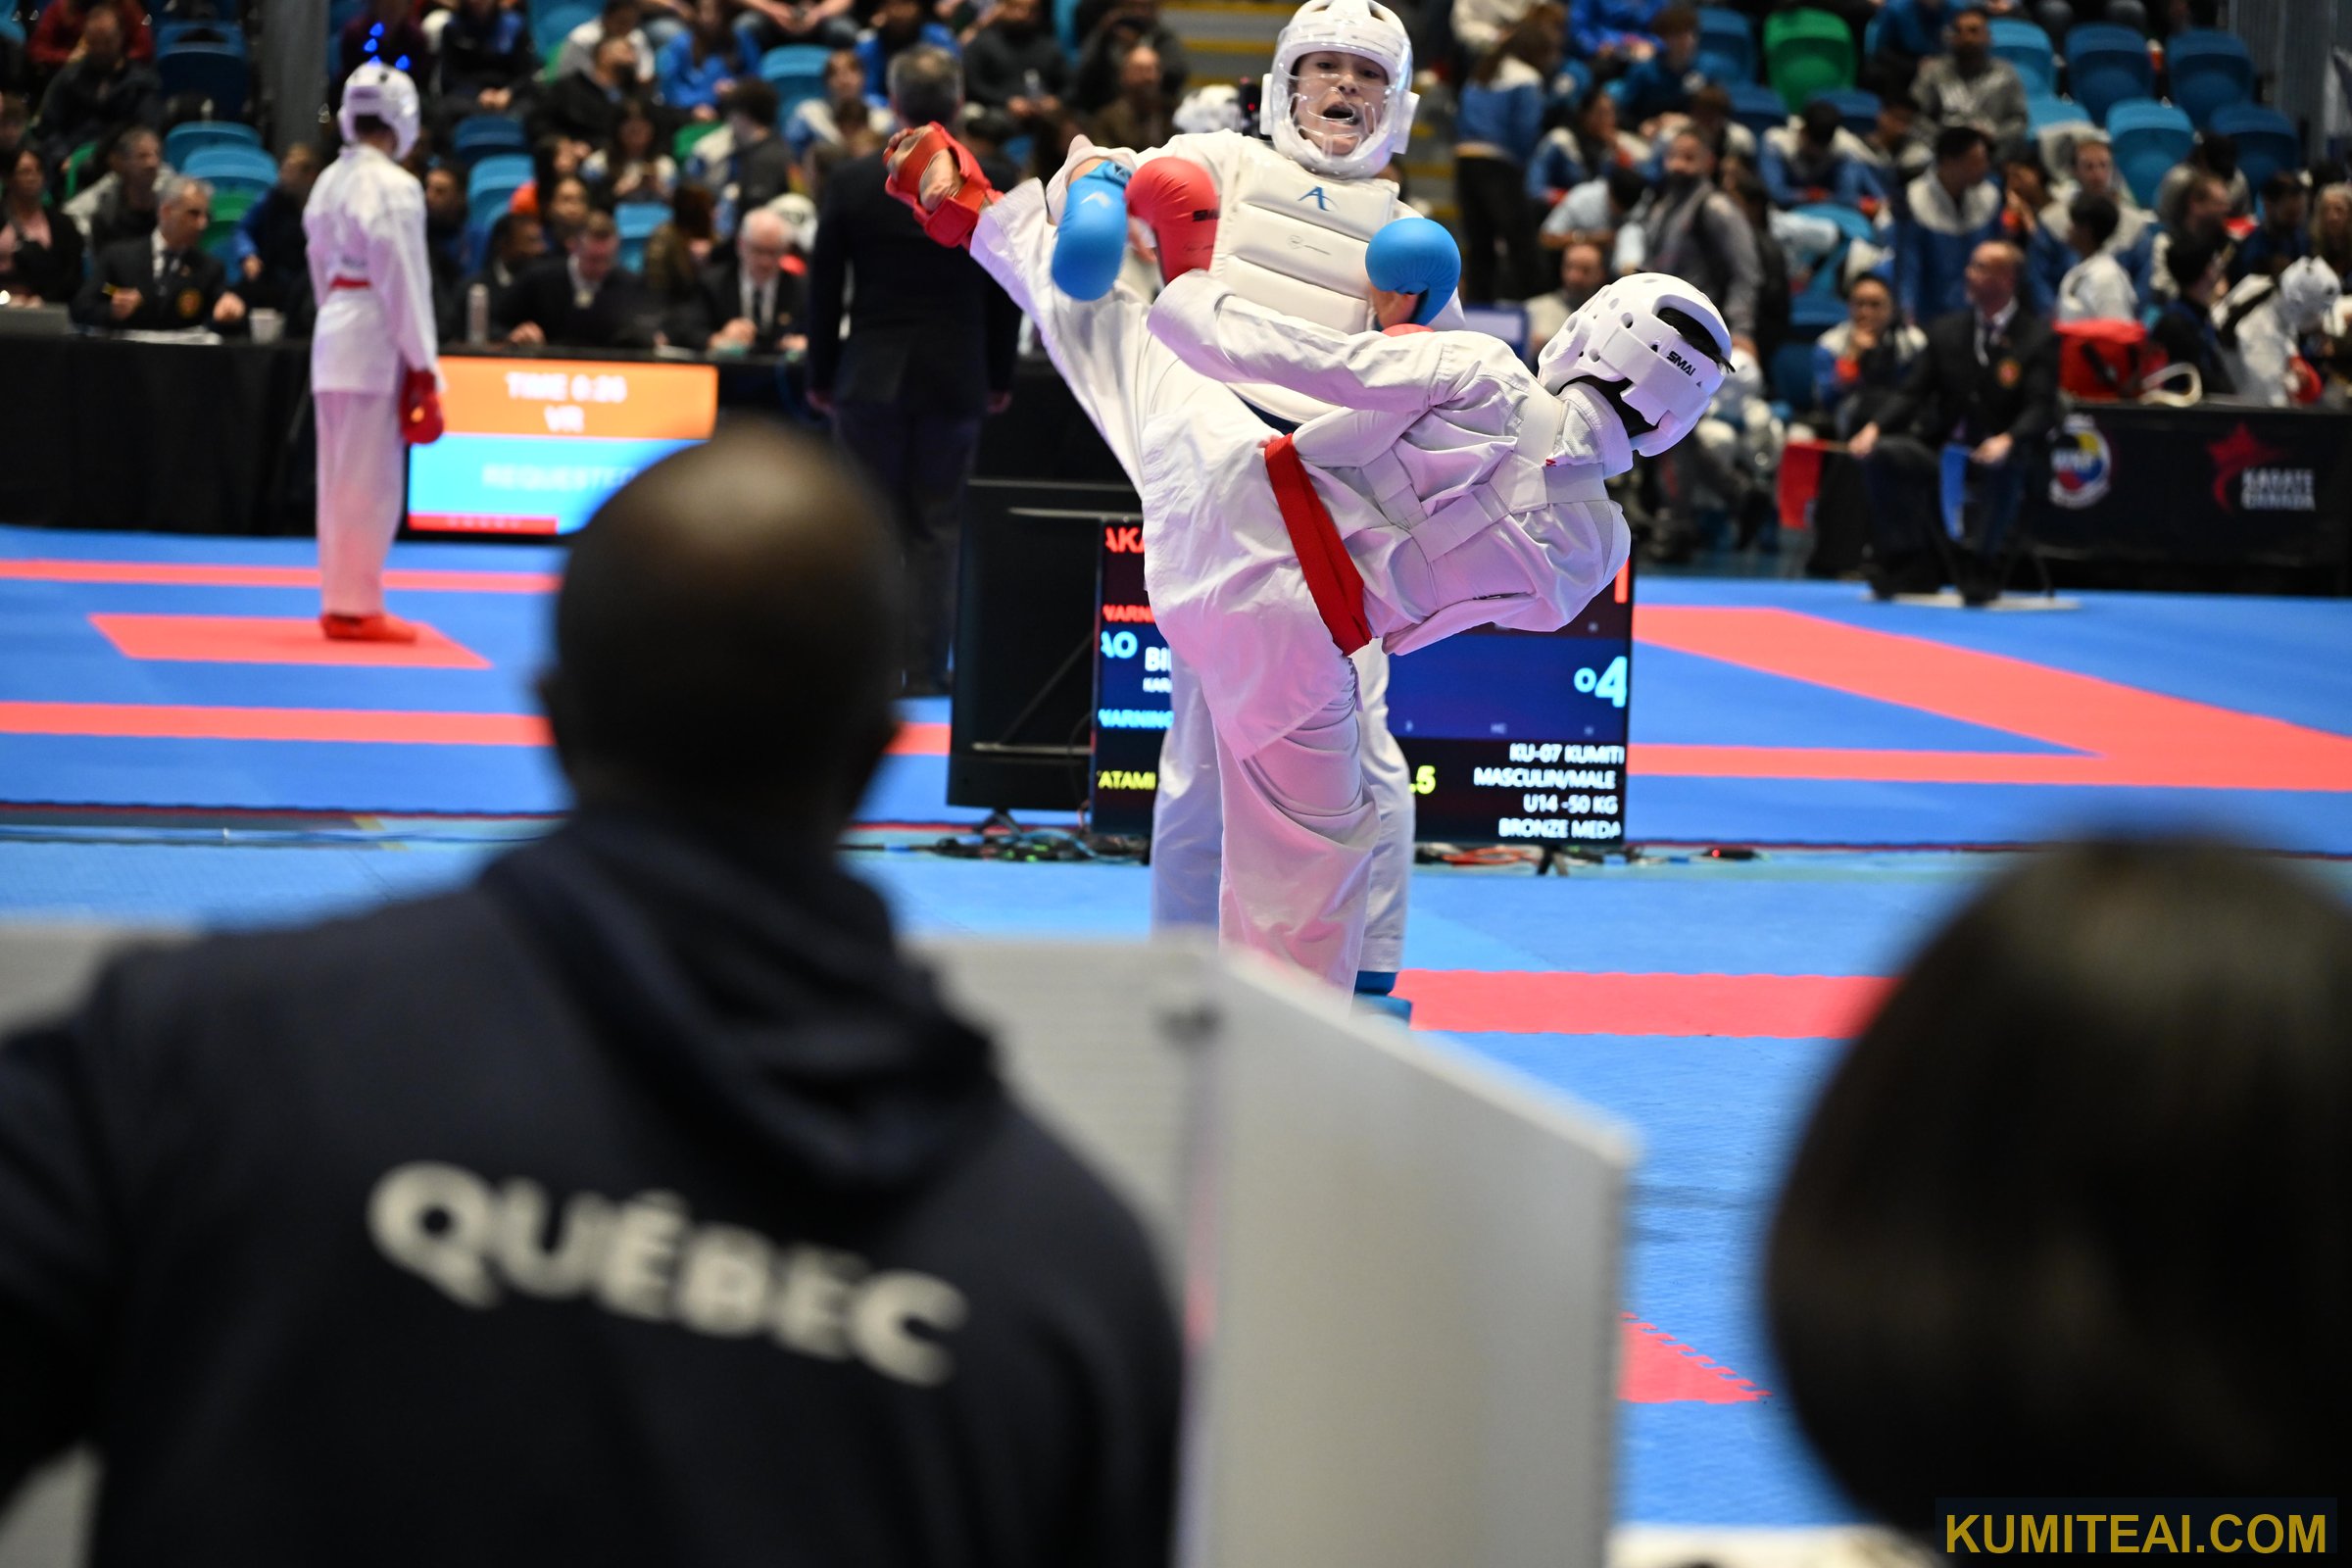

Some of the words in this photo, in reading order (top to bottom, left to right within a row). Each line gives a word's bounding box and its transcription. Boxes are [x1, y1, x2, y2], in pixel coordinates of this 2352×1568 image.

[1666, 351, 1696, 376] SMAI
[505, 371, 568, 402] TIME
[544, 405, 585, 433] VR
[1594, 656, 1628, 709] 4
[1097, 770, 1156, 791] ATAMI
[1473, 767, 1616, 790] MASCULIN/MALE
[1523, 794, 1558, 813] U14
[1592, 795, 1618, 815] KG
[1498, 817, 1568, 839] BRONZE
[367, 1160, 970, 1388] QUÉBEC
